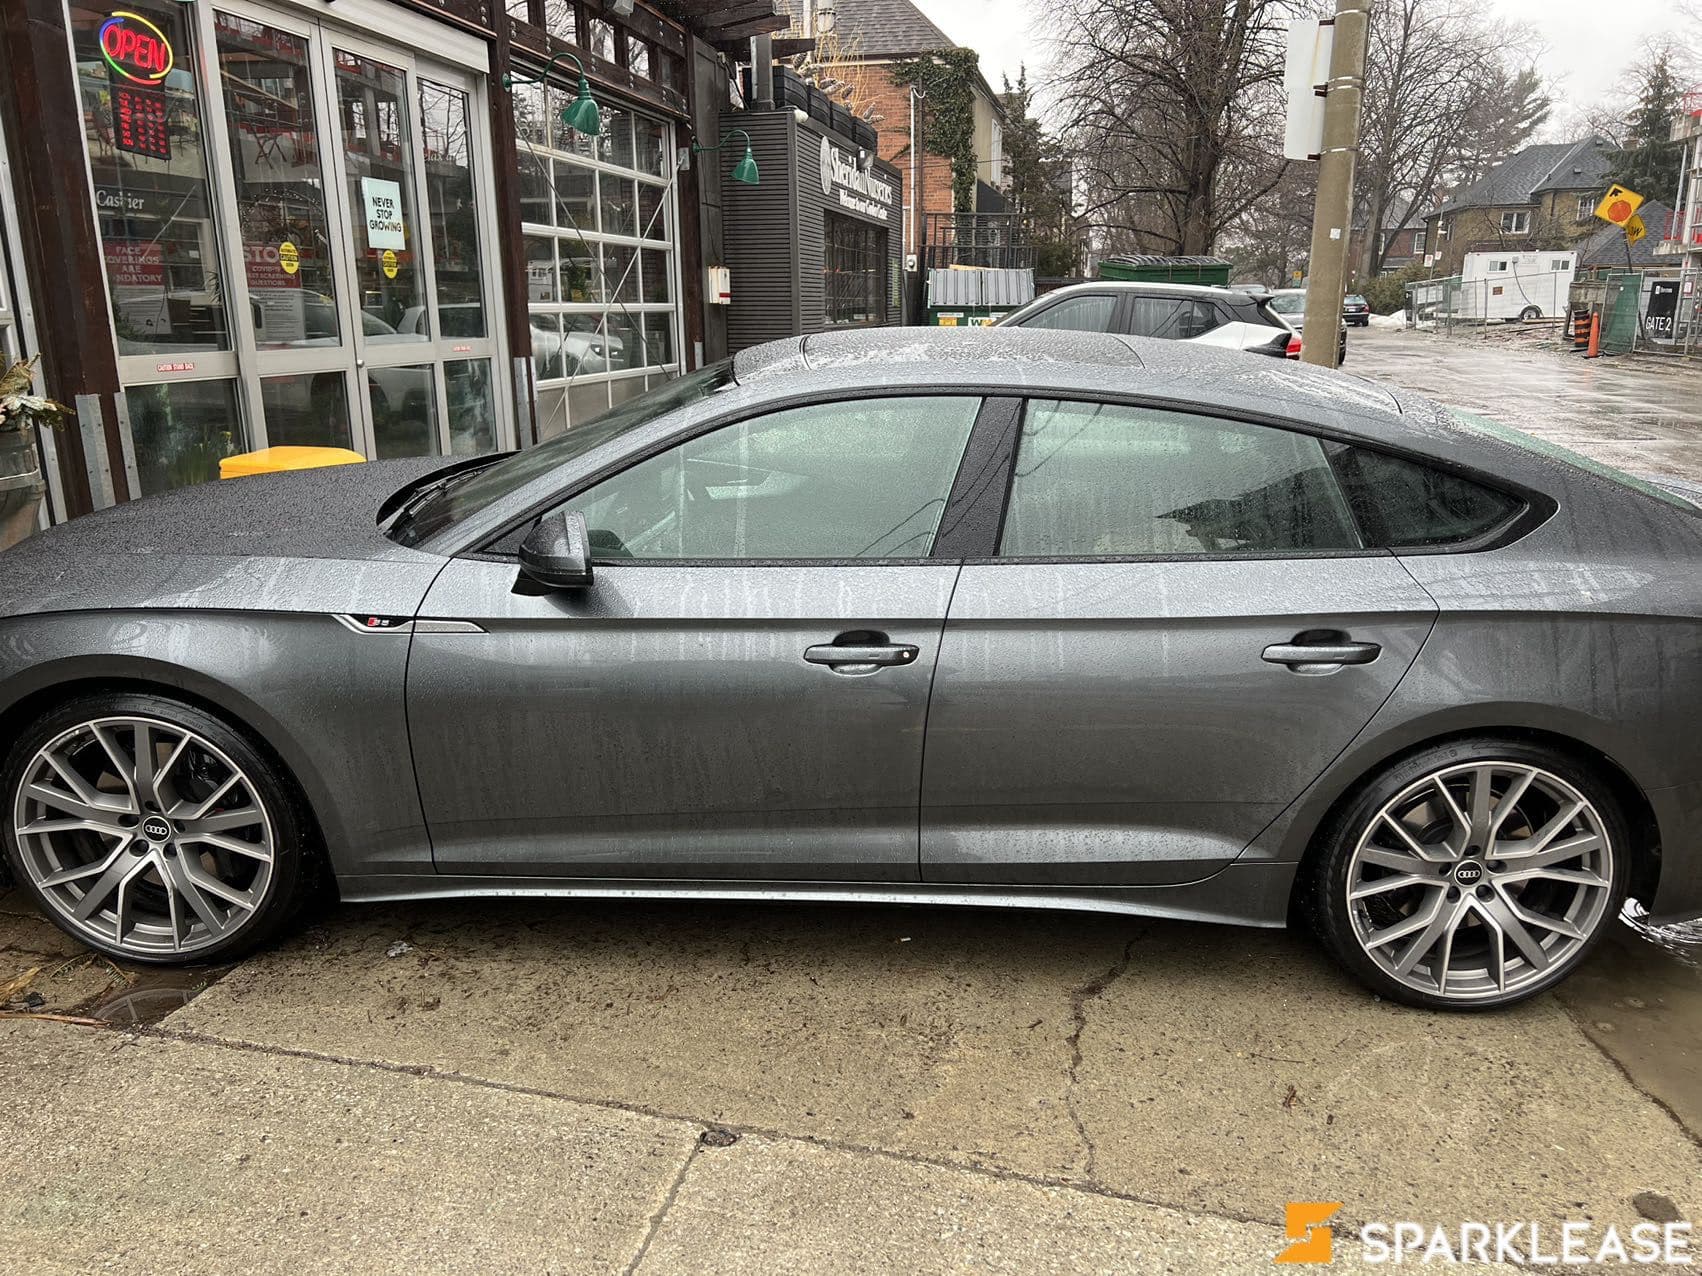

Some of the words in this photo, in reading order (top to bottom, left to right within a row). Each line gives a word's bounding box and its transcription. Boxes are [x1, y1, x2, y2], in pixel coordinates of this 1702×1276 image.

[103, 24, 167, 72] OPEN
[96, 190, 145, 209] Cashier
[372, 196, 395, 209] NEVER
[376, 208, 393, 219] STOP
[369, 219, 402, 232] GROWING
[115, 246, 142, 255] FACE
[243, 245, 280, 263] STO
[121, 264, 144, 273] ARE
[110, 274, 162, 283] NDATORY
[1645, 316, 1666, 331] GATE
[1665, 316, 1673, 331] 2
